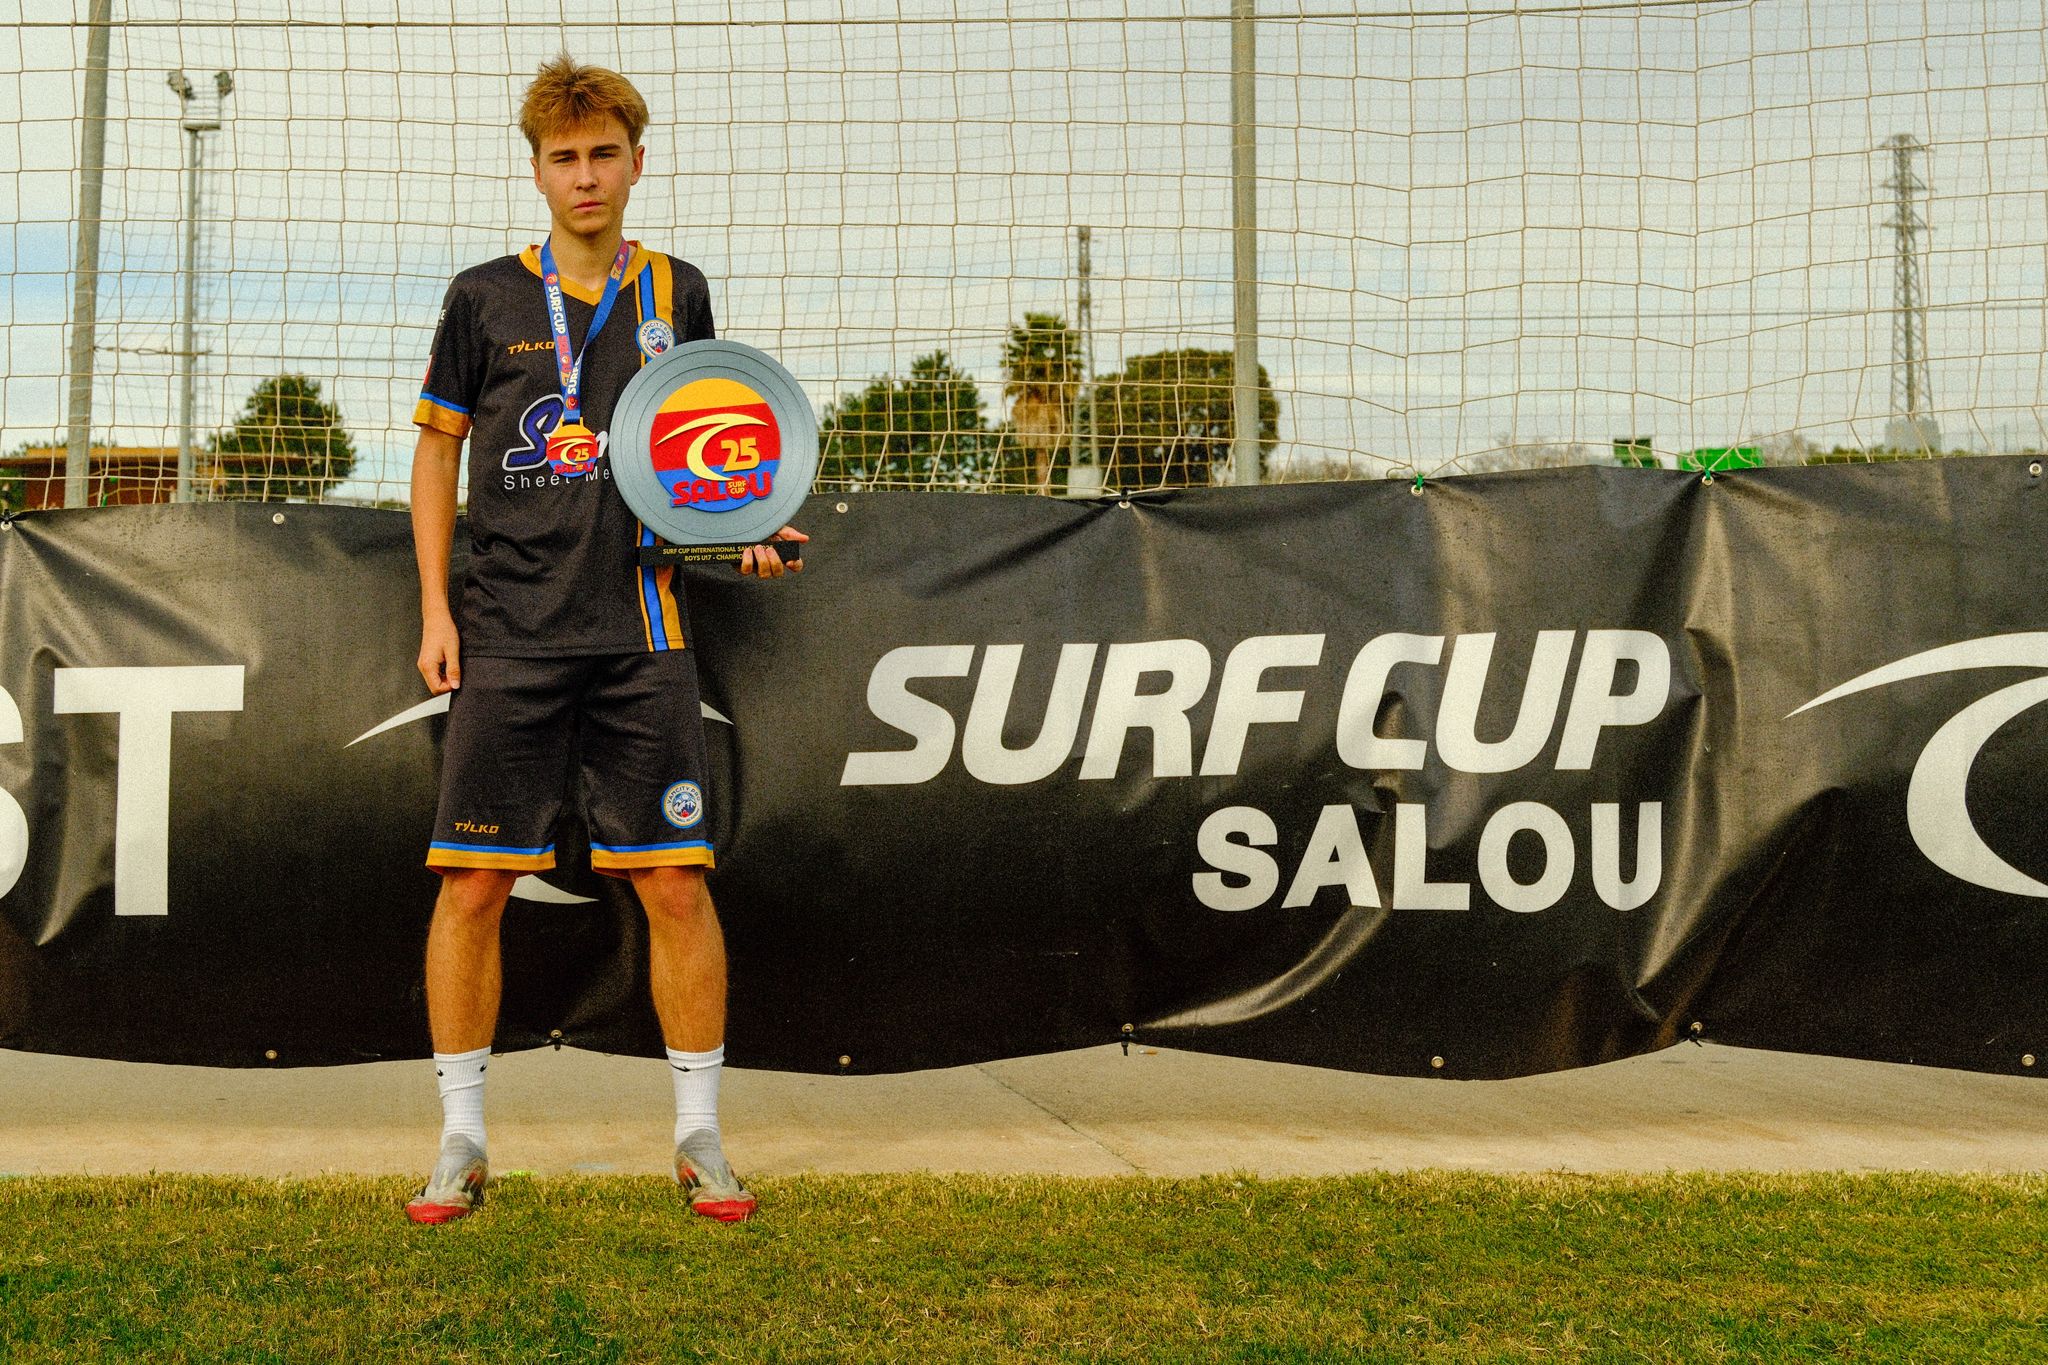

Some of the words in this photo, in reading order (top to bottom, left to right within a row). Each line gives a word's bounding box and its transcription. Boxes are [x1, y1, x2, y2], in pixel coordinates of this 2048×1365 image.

[548, 286, 561, 311] SURF
[553, 312, 566, 334] CUP
[507, 340, 555, 354] TYLKO
[574, 447, 590, 462] 25
[720, 437, 761, 472] 25
[672, 471, 773, 506] SALOU
[727, 480, 747, 489] SURF
[690, 546, 737, 554] INTERNATIONAL
[840, 633, 1326, 786] SURF
[1336, 629, 1672, 774] CUP
[0, 665, 245, 916] T
[454, 819, 499, 834] TYLKO
[1192, 801, 1663, 914] SALOU
